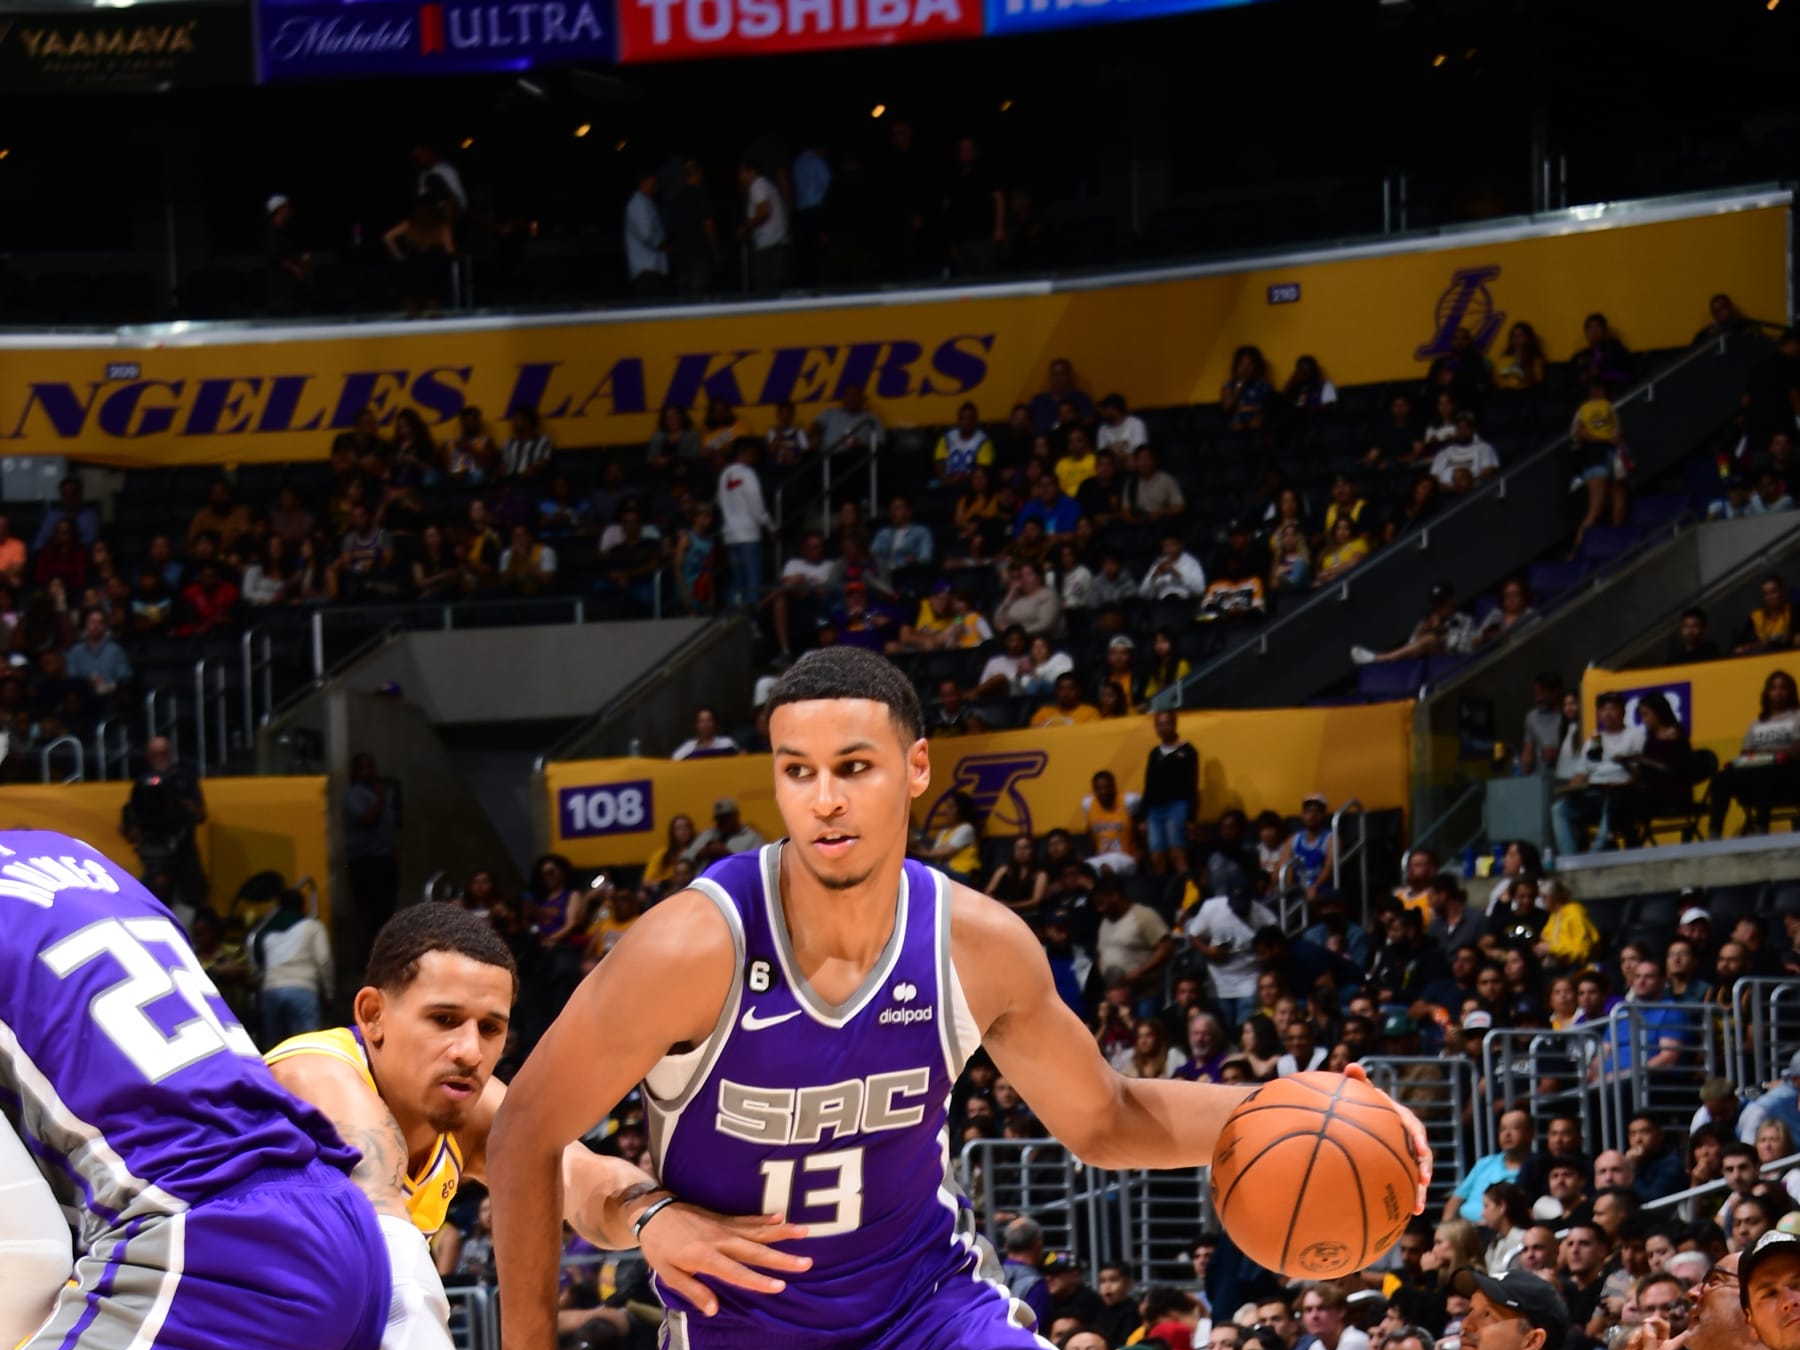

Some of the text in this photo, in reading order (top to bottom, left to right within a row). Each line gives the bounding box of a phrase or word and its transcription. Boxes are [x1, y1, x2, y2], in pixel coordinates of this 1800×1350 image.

[448, 2, 605, 50] ULTRA
[640, 0, 963, 44] TOSHIBA
[500, 333, 996, 420] LAKERS
[566, 788, 645, 831] 108
[748, 960, 771, 993] 6
[38, 916, 263, 1086] 22
[878, 1004, 933, 1026] dialpad
[715, 1066, 930, 1146] SAC
[759, 1146, 866, 1239] 13
